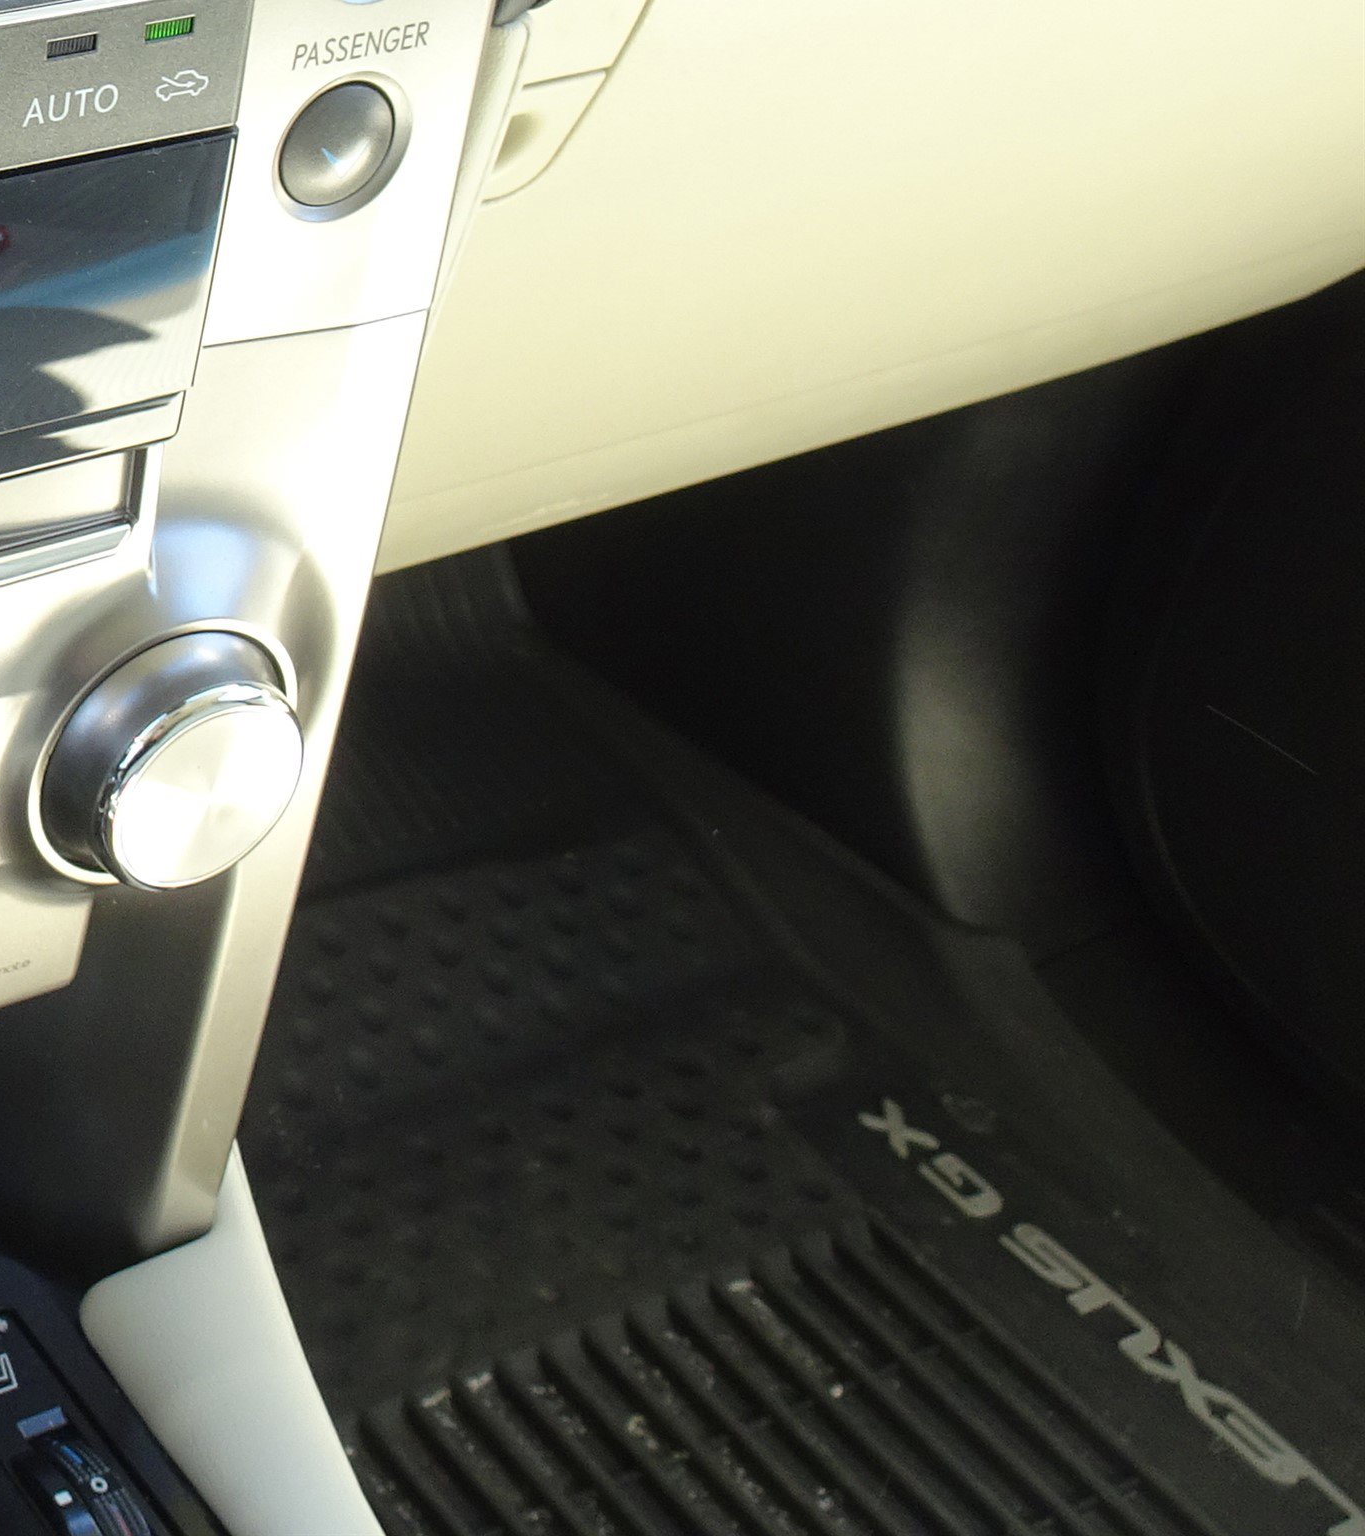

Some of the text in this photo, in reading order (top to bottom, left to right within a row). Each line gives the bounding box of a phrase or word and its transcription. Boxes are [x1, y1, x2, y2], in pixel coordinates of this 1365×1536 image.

[292, 20, 430, 71] PASSENGER
[22, 82, 119, 128] AUTO
[857, 1097, 1004, 1219] GX
